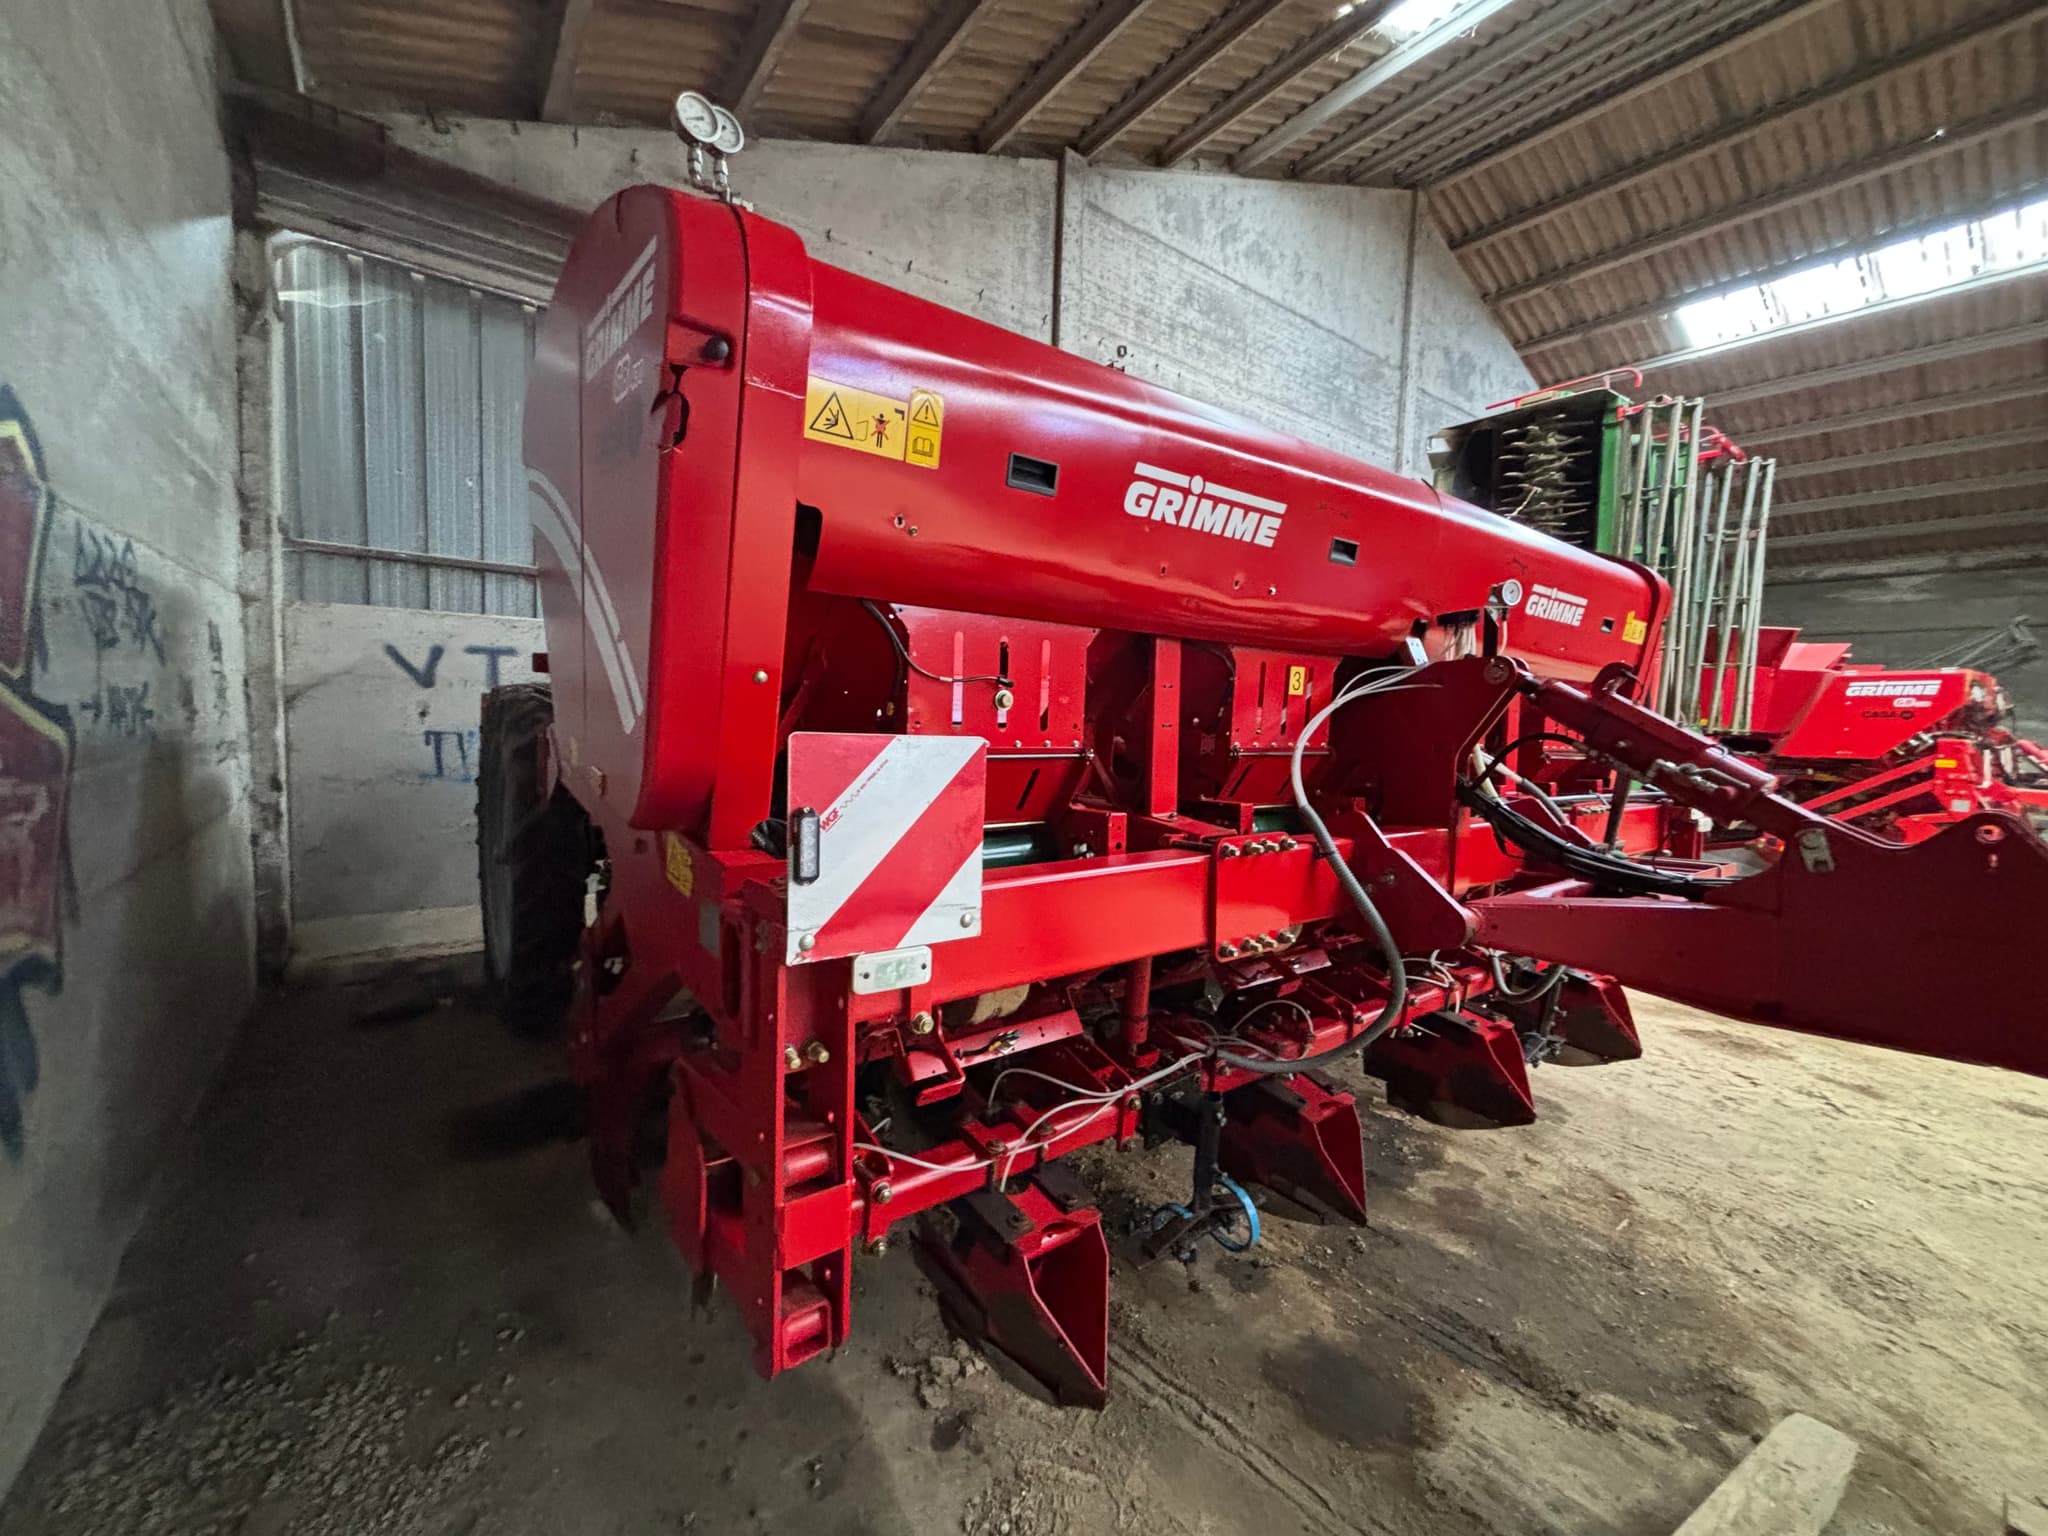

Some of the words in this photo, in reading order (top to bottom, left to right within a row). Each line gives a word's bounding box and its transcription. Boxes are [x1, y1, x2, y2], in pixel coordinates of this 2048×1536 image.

[585, 250, 657, 383] GRIMME
[1123, 470, 1283, 548] GRIMME
[1525, 587, 1586, 627] GRIMME
[1292, 671, 1301, 691] 3
[1846, 682, 1942, 697] GRIMME
